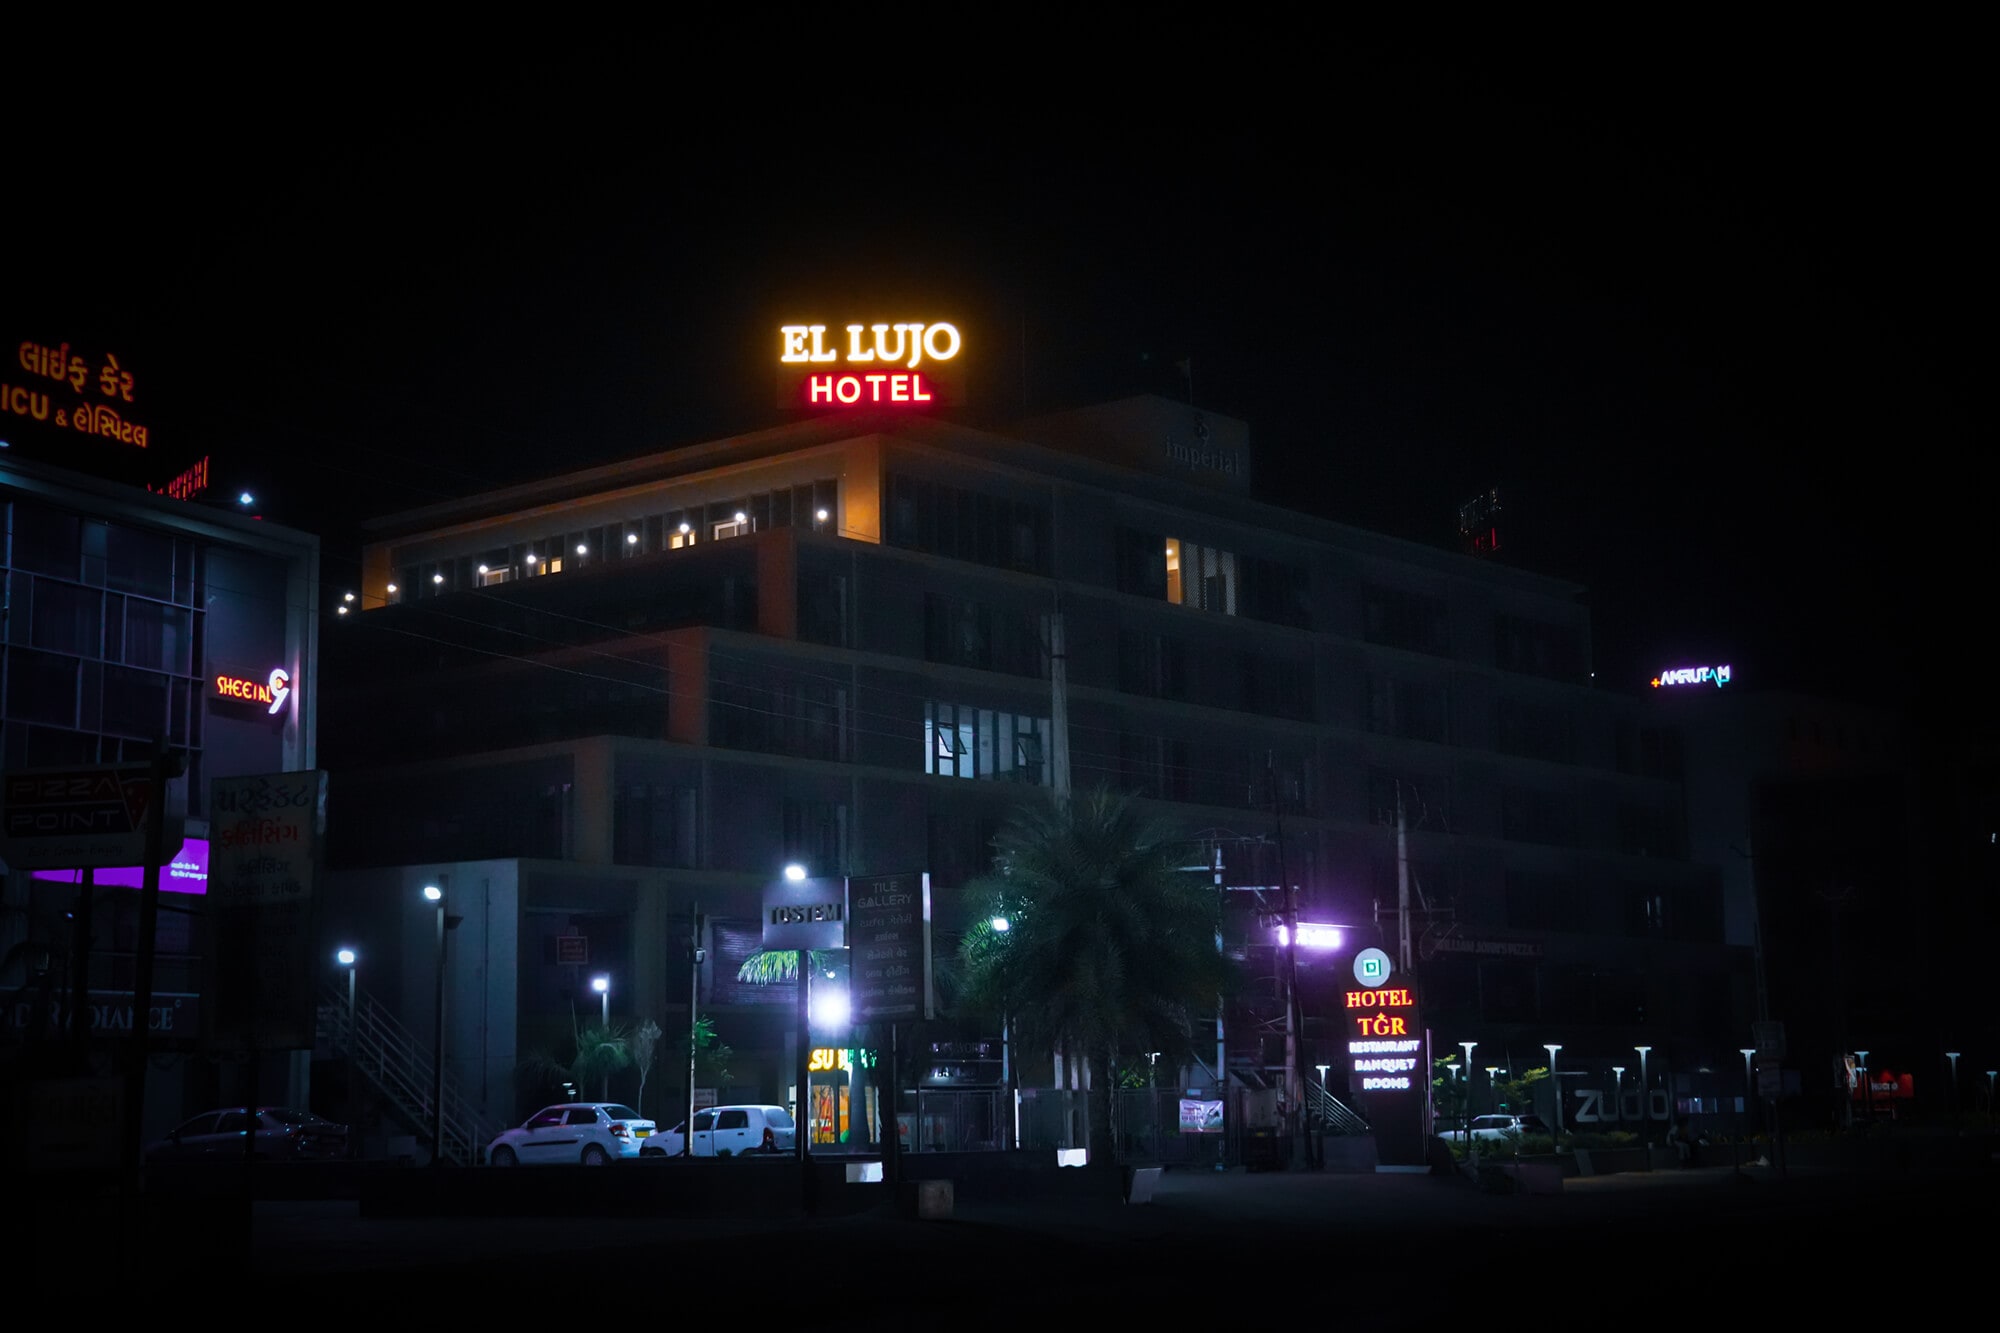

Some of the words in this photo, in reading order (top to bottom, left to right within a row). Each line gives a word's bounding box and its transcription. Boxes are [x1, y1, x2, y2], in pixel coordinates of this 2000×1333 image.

[780, 325, 837, 362] EL
[846, 322, 961, 369] LUJO
[19, 341, 89, 394] લાઈફ
[99, 352, 134, 402] કેર
[811, 374, 931, 403] HOTEL
[0, 383, 49, 421] ICU
[55, 408, 68, 427] &
[73, 402, 148, 449] હોસ્પિટલ
[1660, 665, 1731, 688] AMRUTAM
[12, 776, 118, 799] PIZZA
[11, 808, 121, 831] POINT
[872, 881, 898, 893] TILE
[856, 893, 912, 908] GALLERY
[1346, 989, 1413, 1008] HOTEL
[1357, 1015, 1407, 1036] TGR
[1348, 1039, 1420, 1054] RESTAURANT
[1354, 1058, 1417, 1073] BANQUET
[1362, 1077, 1410, 1091] ROOMS
